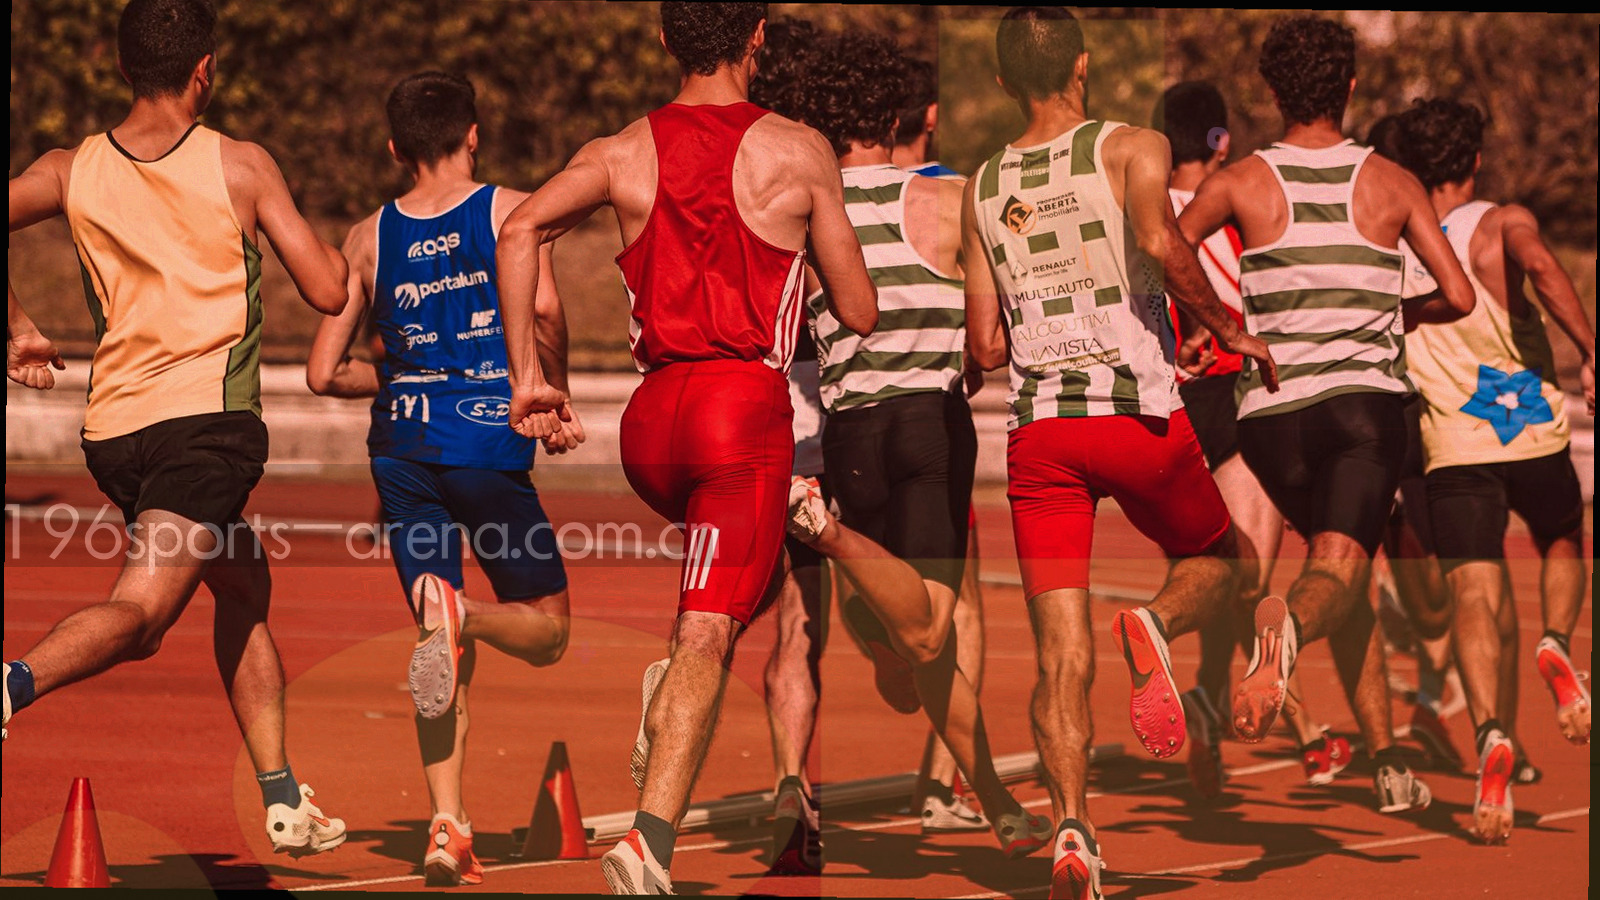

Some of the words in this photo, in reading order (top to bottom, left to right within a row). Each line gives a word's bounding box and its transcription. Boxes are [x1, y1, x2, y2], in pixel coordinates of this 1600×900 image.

[1037, 196, 1078, 213] ABERTA
[1032, 257, 1077, 273] RENAULT
[419, 270, 489, 299] portalum
[1014, 277, 1095, 304] MULTIAUTO
[470, 309, 496, 328] NF
[1016, 311, 1111, 344] ALCOUTIM
[406, 332, 438, 350] group
